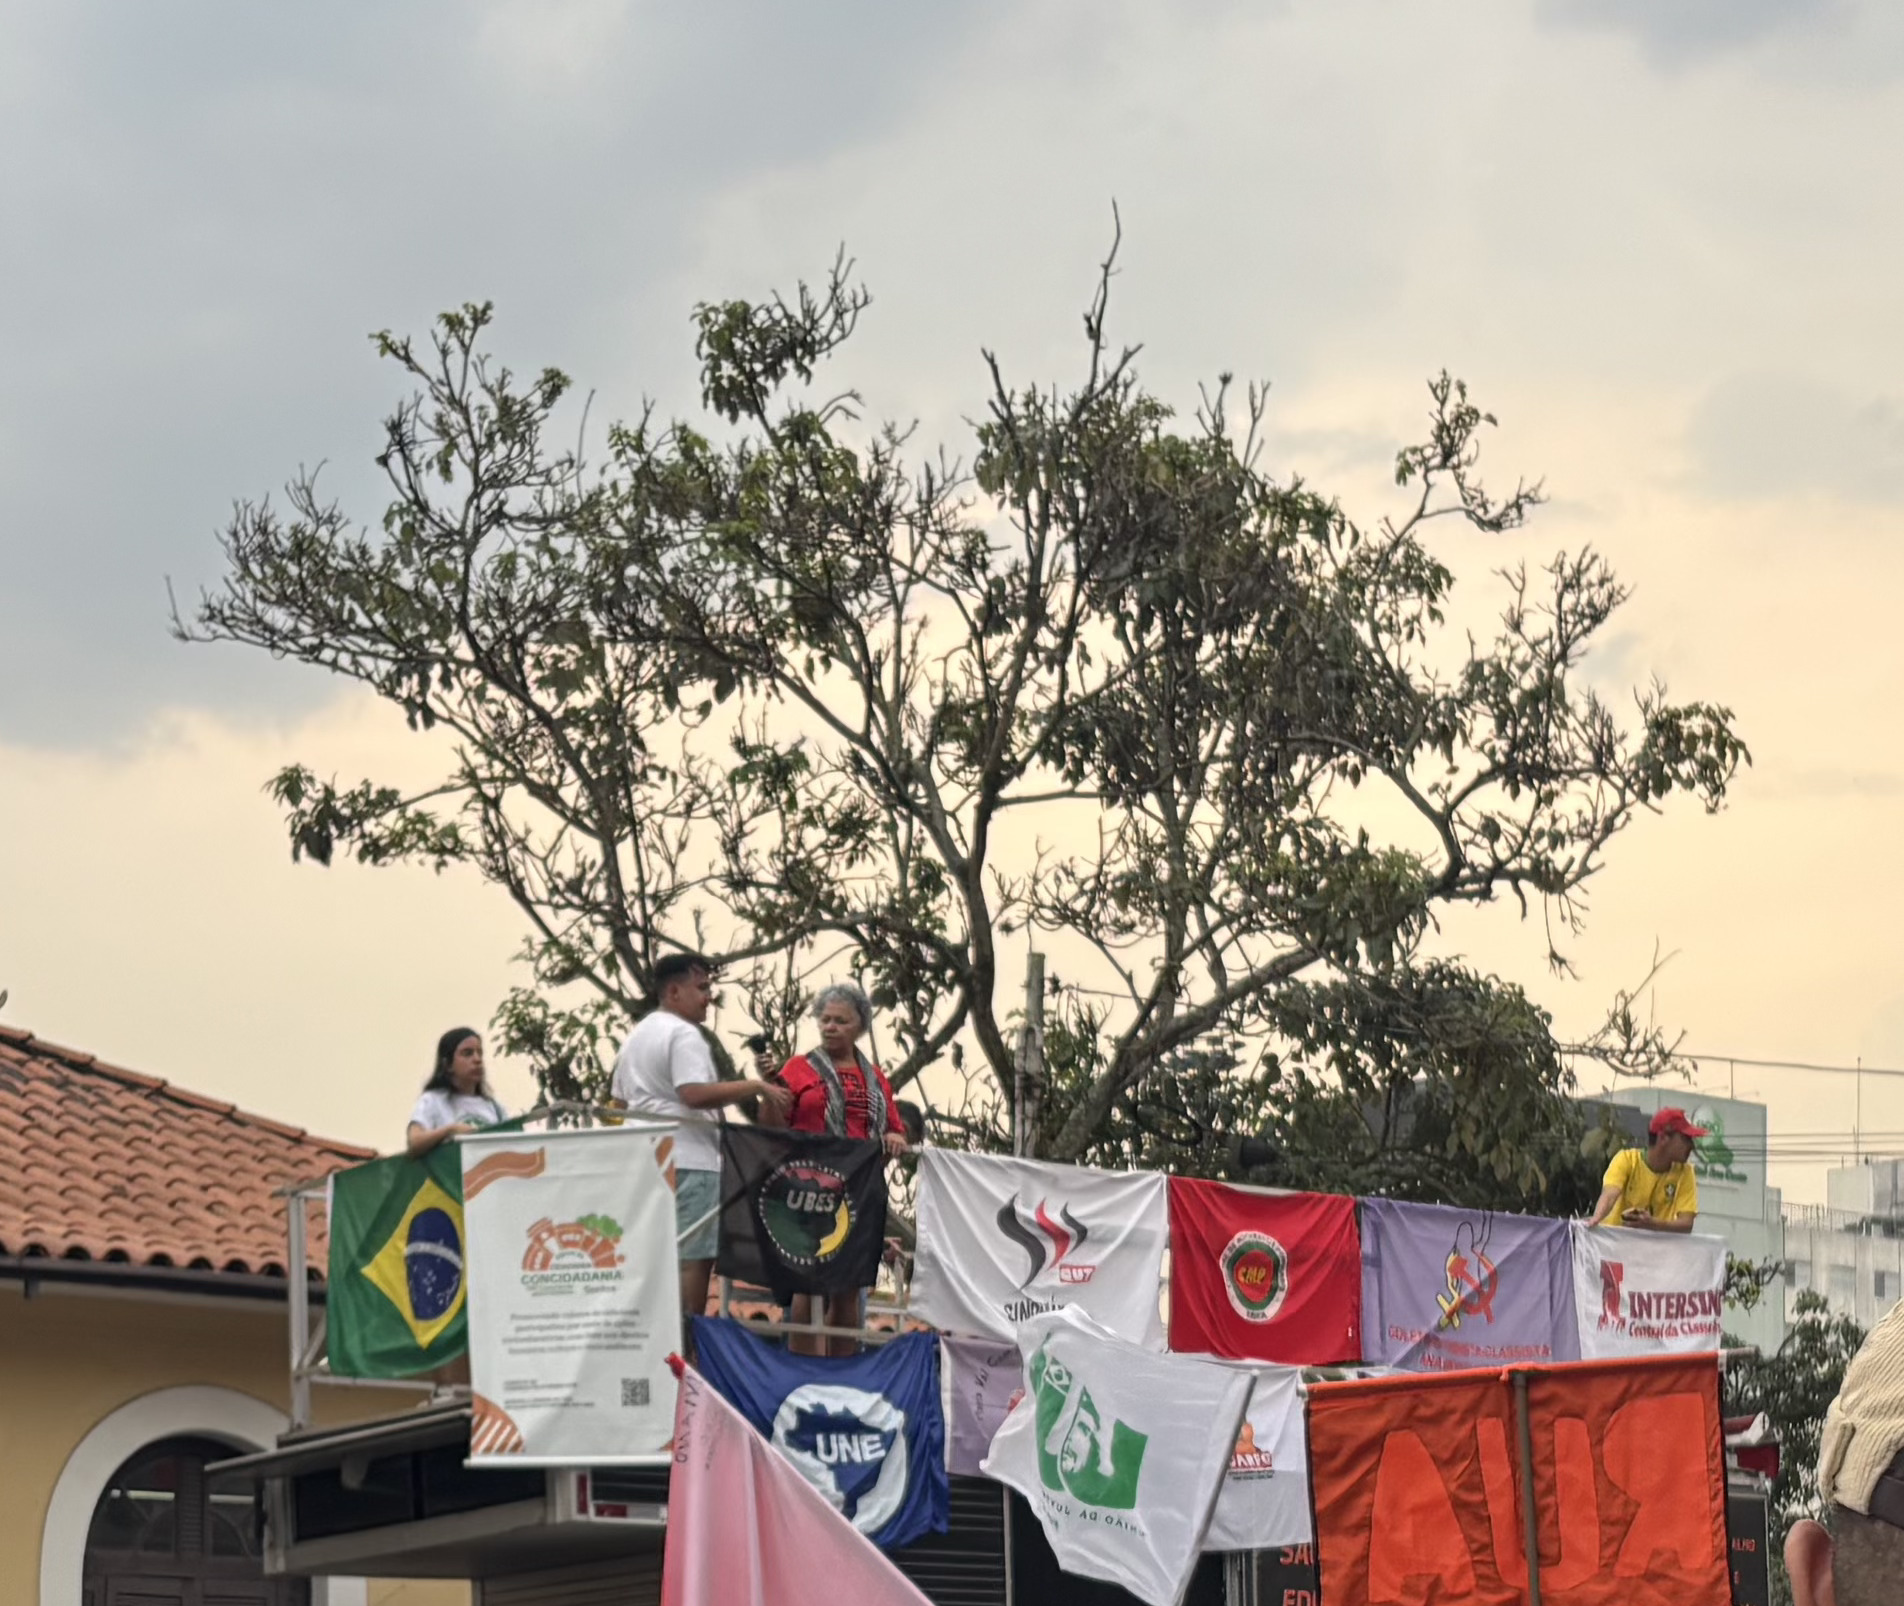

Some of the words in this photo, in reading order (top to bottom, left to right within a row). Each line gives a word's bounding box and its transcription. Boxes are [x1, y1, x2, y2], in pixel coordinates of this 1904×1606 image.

[786, 1189, 836, 1212] UBES
[520, 1271, 623, 1285] CONCIDADANIA
[1628, 1291, 1724, 1320] INTERSIN
[816, 1433, 886, 1463] UNE
